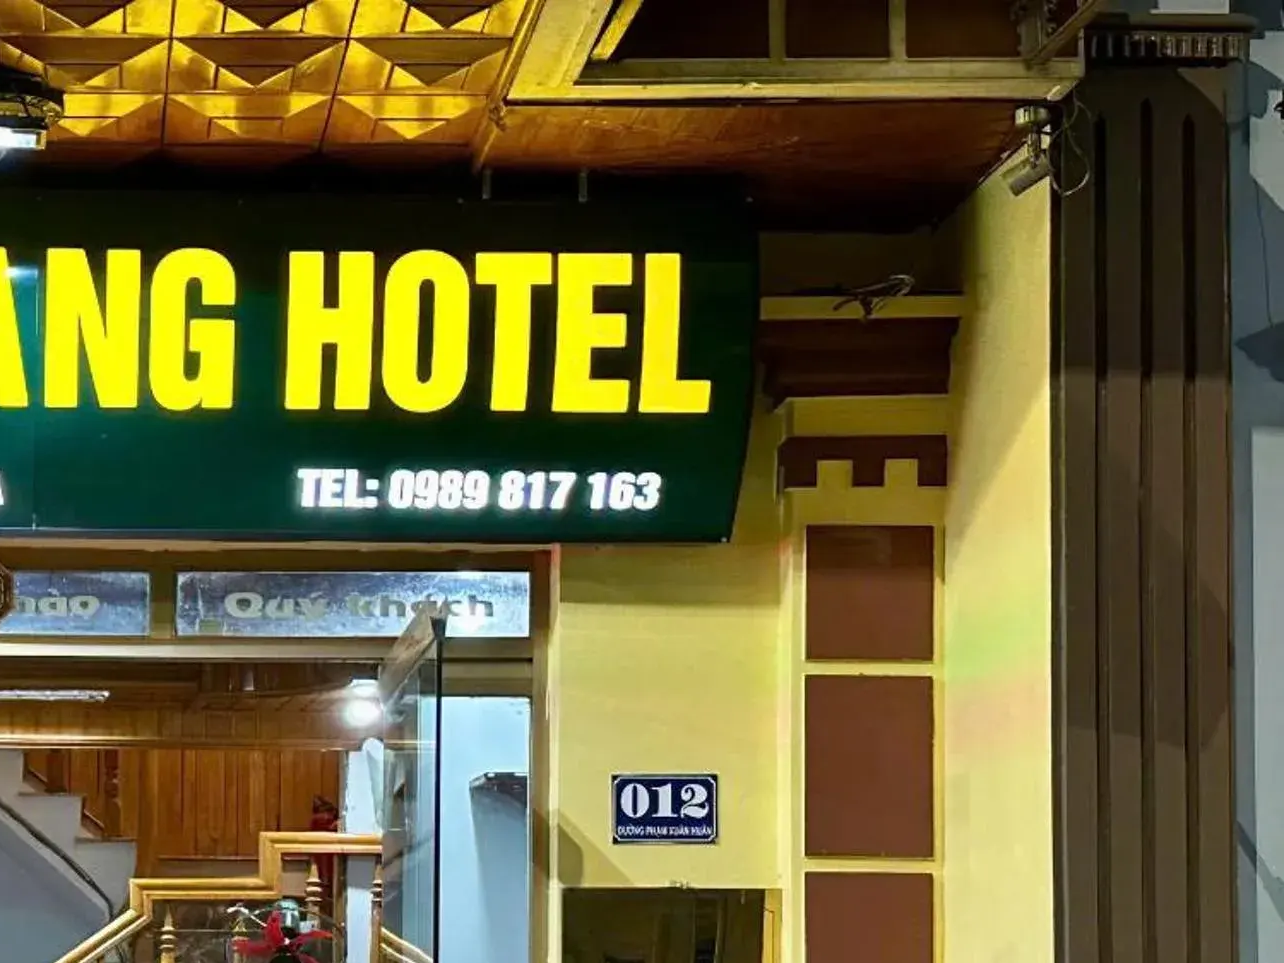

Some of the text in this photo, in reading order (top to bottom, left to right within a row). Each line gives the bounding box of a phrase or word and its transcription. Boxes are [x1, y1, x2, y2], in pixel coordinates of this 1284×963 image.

[284, 249, 711, 413] HOTEL
[297, 469, 662, 510] TEL: 0989 817 163
[620, 783, 709, 818] 012
